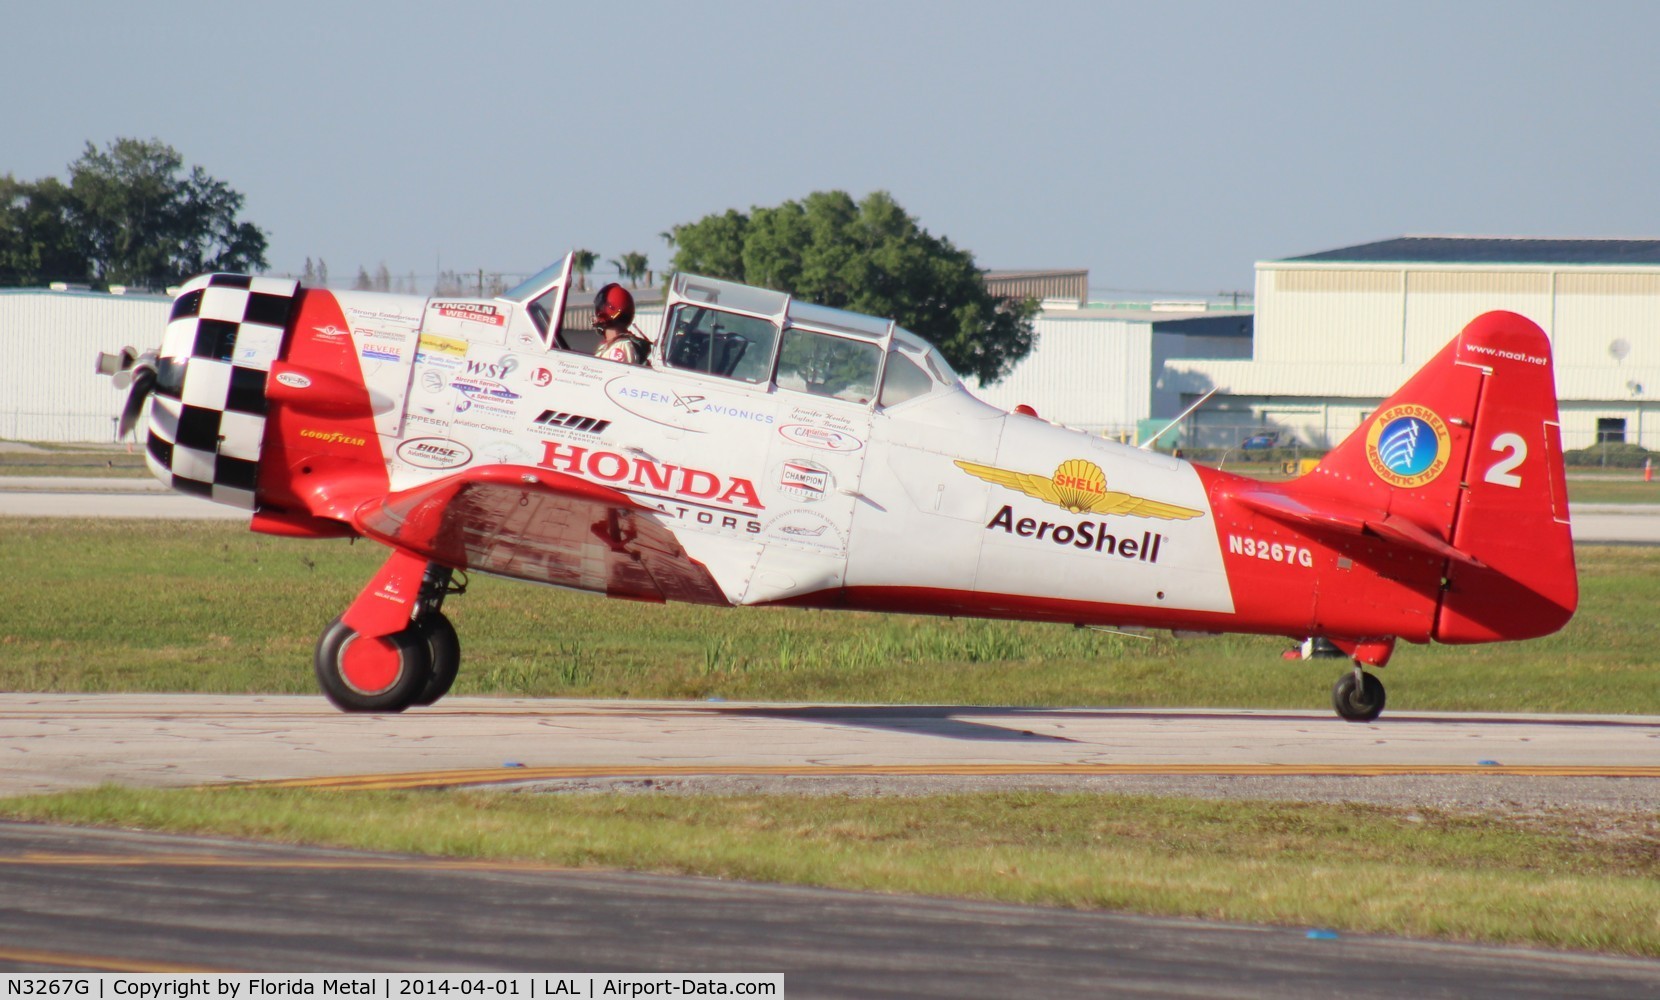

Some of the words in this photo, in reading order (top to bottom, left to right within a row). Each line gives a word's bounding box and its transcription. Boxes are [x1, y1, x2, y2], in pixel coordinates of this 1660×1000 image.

[434, 303, 495, 315] LINCOLN
[445, 310, 497, 325] WELDERS
[363, 343, 401, 354] REVERE
[1466, 343, 1548, 366] www.naat.net
[455, 376, 479, 385] Aircraft
[619, 387, 669, 404] ASPEN
[704, 404, 774, 424] AVIONICS
[404, 413, 449, 427] EPPESEN
[453, 419, 480, 429] Aviation
[480, 423, 502, 433] Covers
[1379, 406, 1447, 441] AEROSHELL
[300, 429, 365, 446] GOODYEAR
[526, 427, 565, 438] Insurance
[570, 431, 601, 441] Aviation
[407, 449, 431, 459] Aviation
[431, 453, 454, 464] Headset
[416, 443, 458, 458] BOSE
[1368, 444, 1415, 485] AEROBATIC
[1484, 432, 1528, 488] 2
[537, 440, 766, 510] HONDA
[784, 471, 822, 486] CHAMPION
[1416, 459, 1444, 483] TEAM
[1056, 474, 1103, 495] SHELL
[986, 504, 1162, 564] AeroShell
[1228, 534, 1313, 568] N3267G
